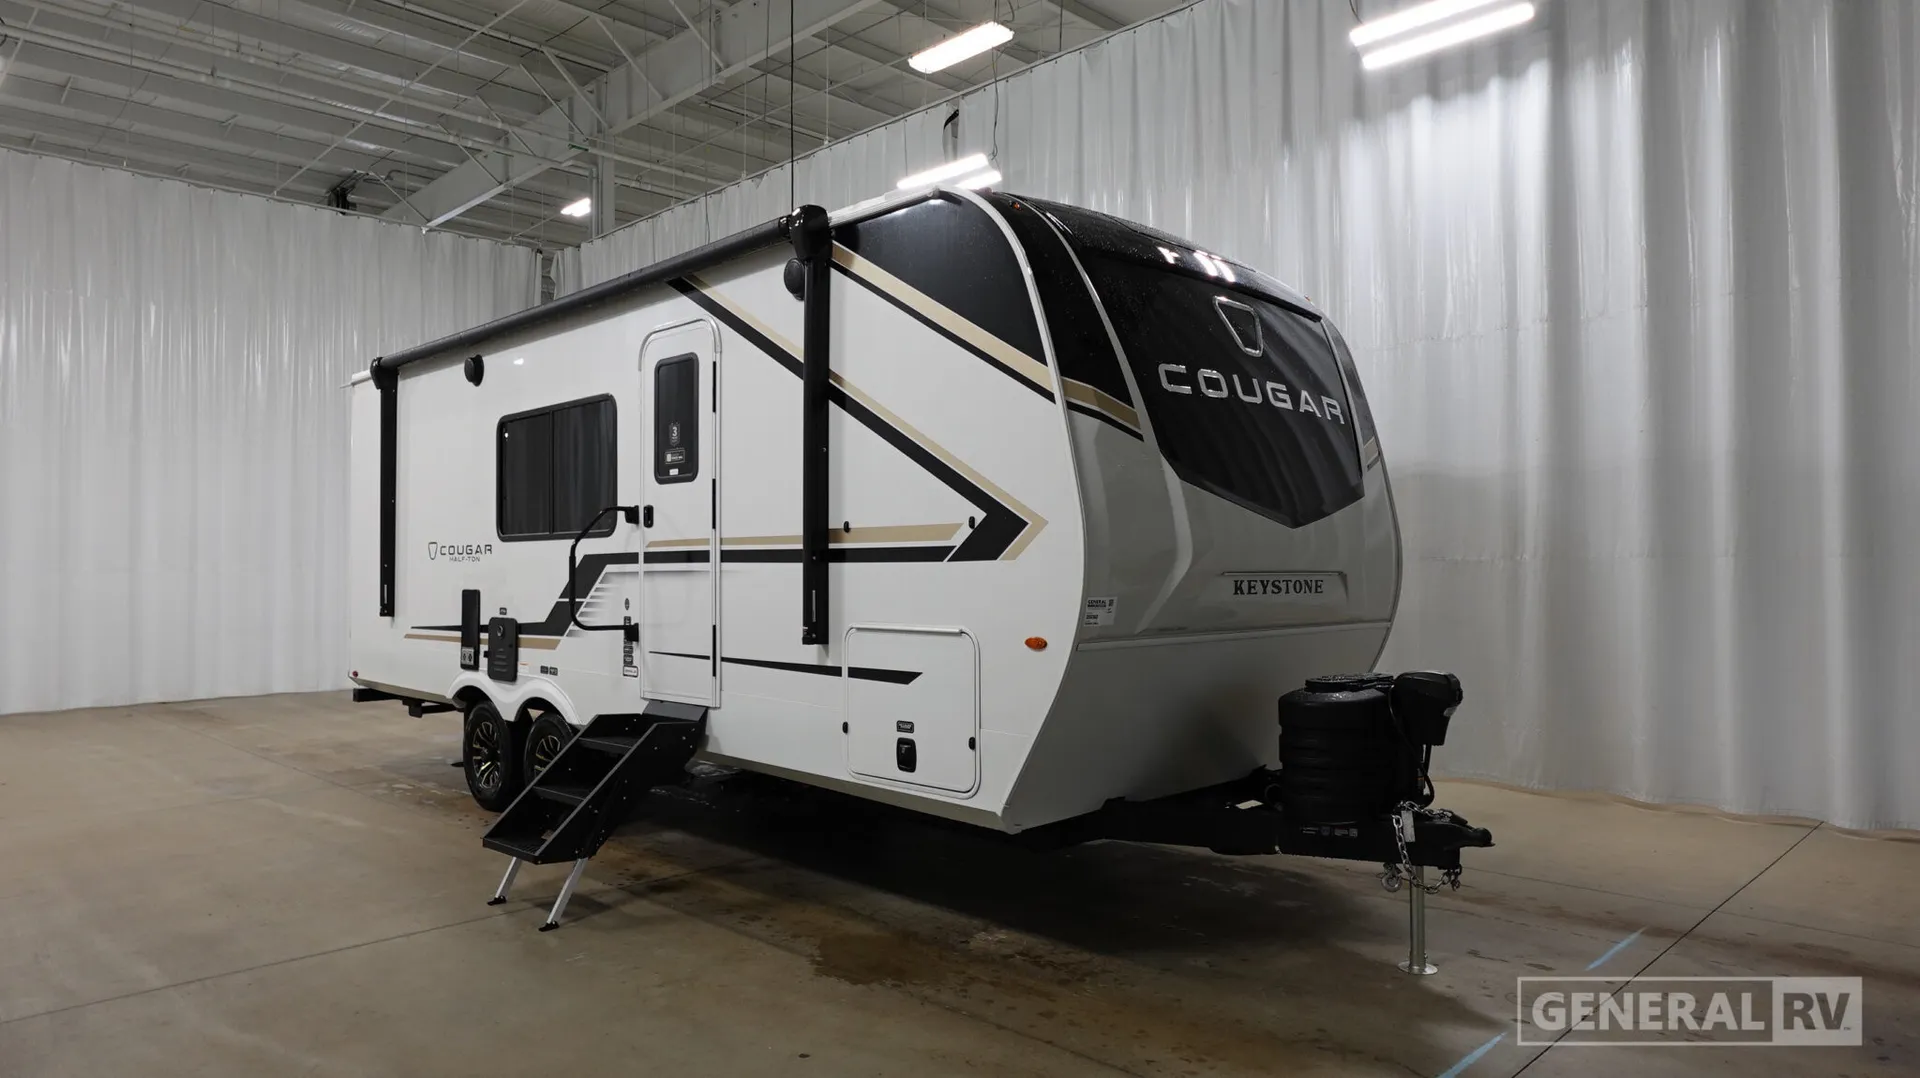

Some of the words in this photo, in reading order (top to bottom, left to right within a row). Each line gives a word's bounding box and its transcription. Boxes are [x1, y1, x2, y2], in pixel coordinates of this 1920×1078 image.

[1158, 363, 1345, 425] COUGAR
[440, 544, 493, 556] COUGAR
[1233, 579, 1324, 595] KEYSTONE
